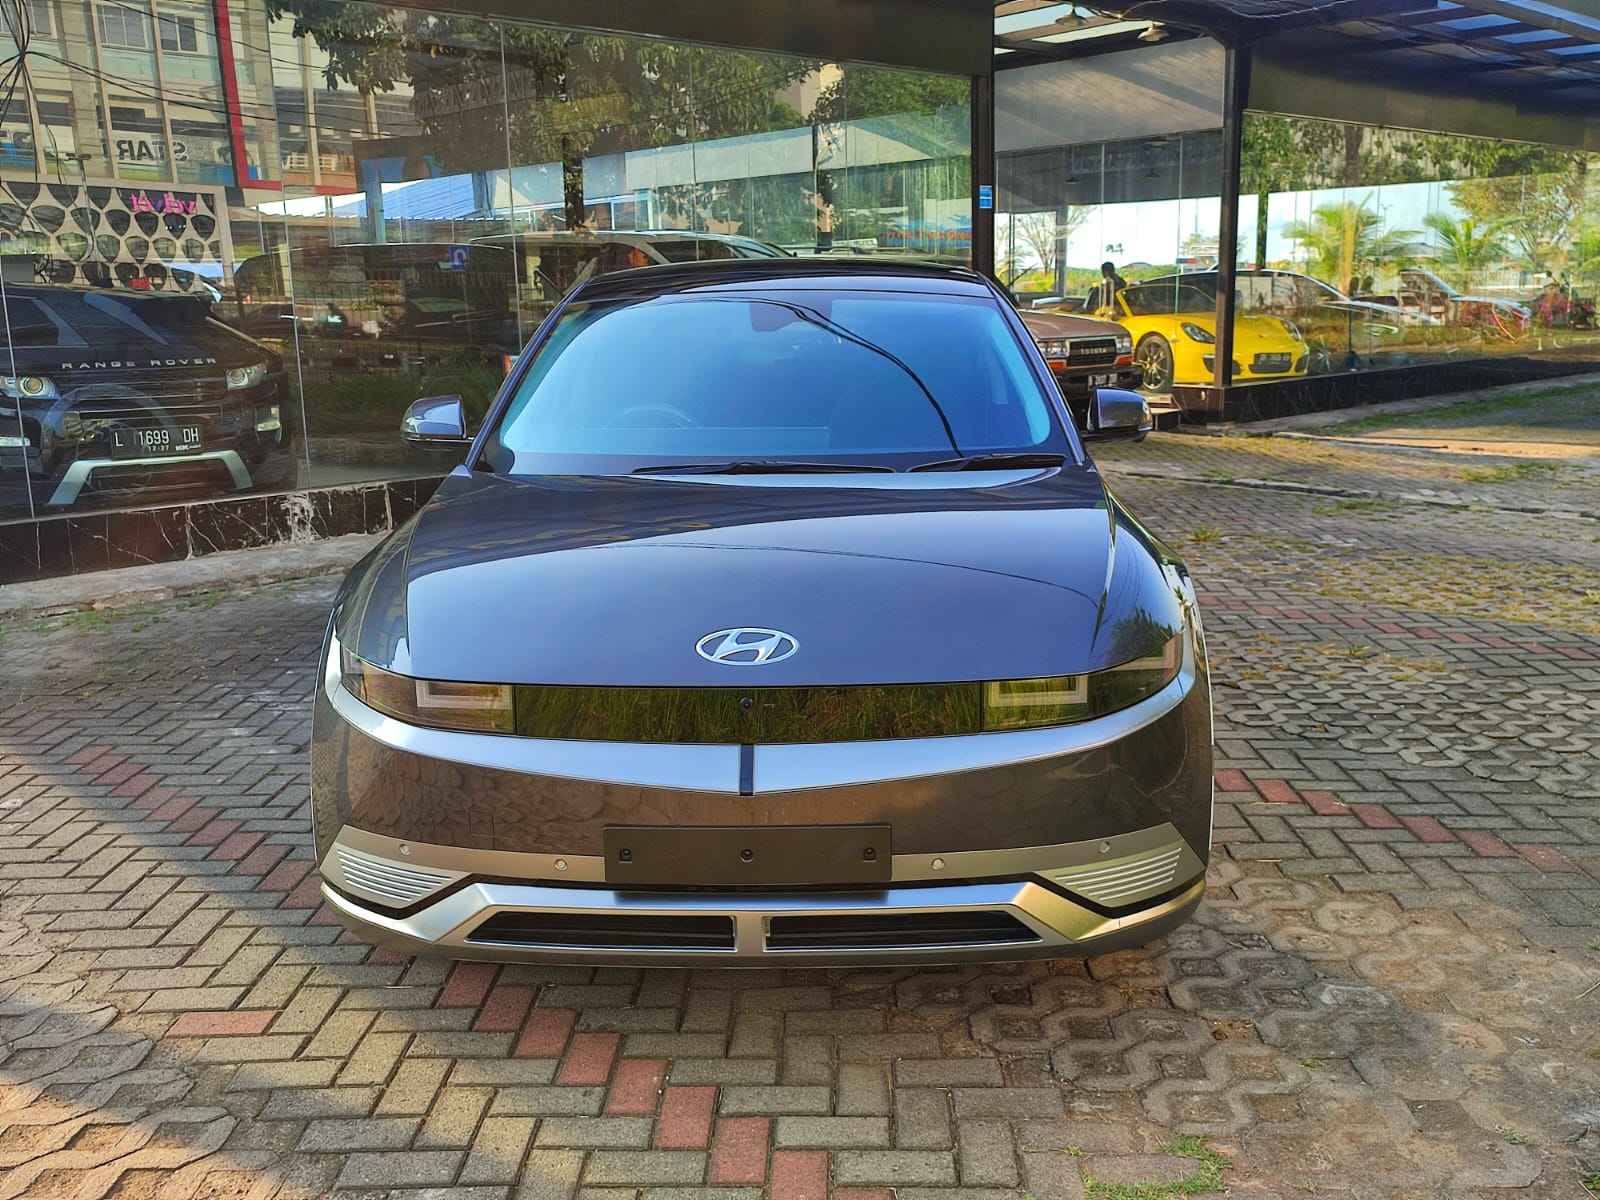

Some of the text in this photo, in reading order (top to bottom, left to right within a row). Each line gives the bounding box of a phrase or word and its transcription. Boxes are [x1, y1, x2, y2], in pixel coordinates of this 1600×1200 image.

[61, 357, 217, 370] RANGE ROVER
[114, 427, 199, 447] L 1699 DH
